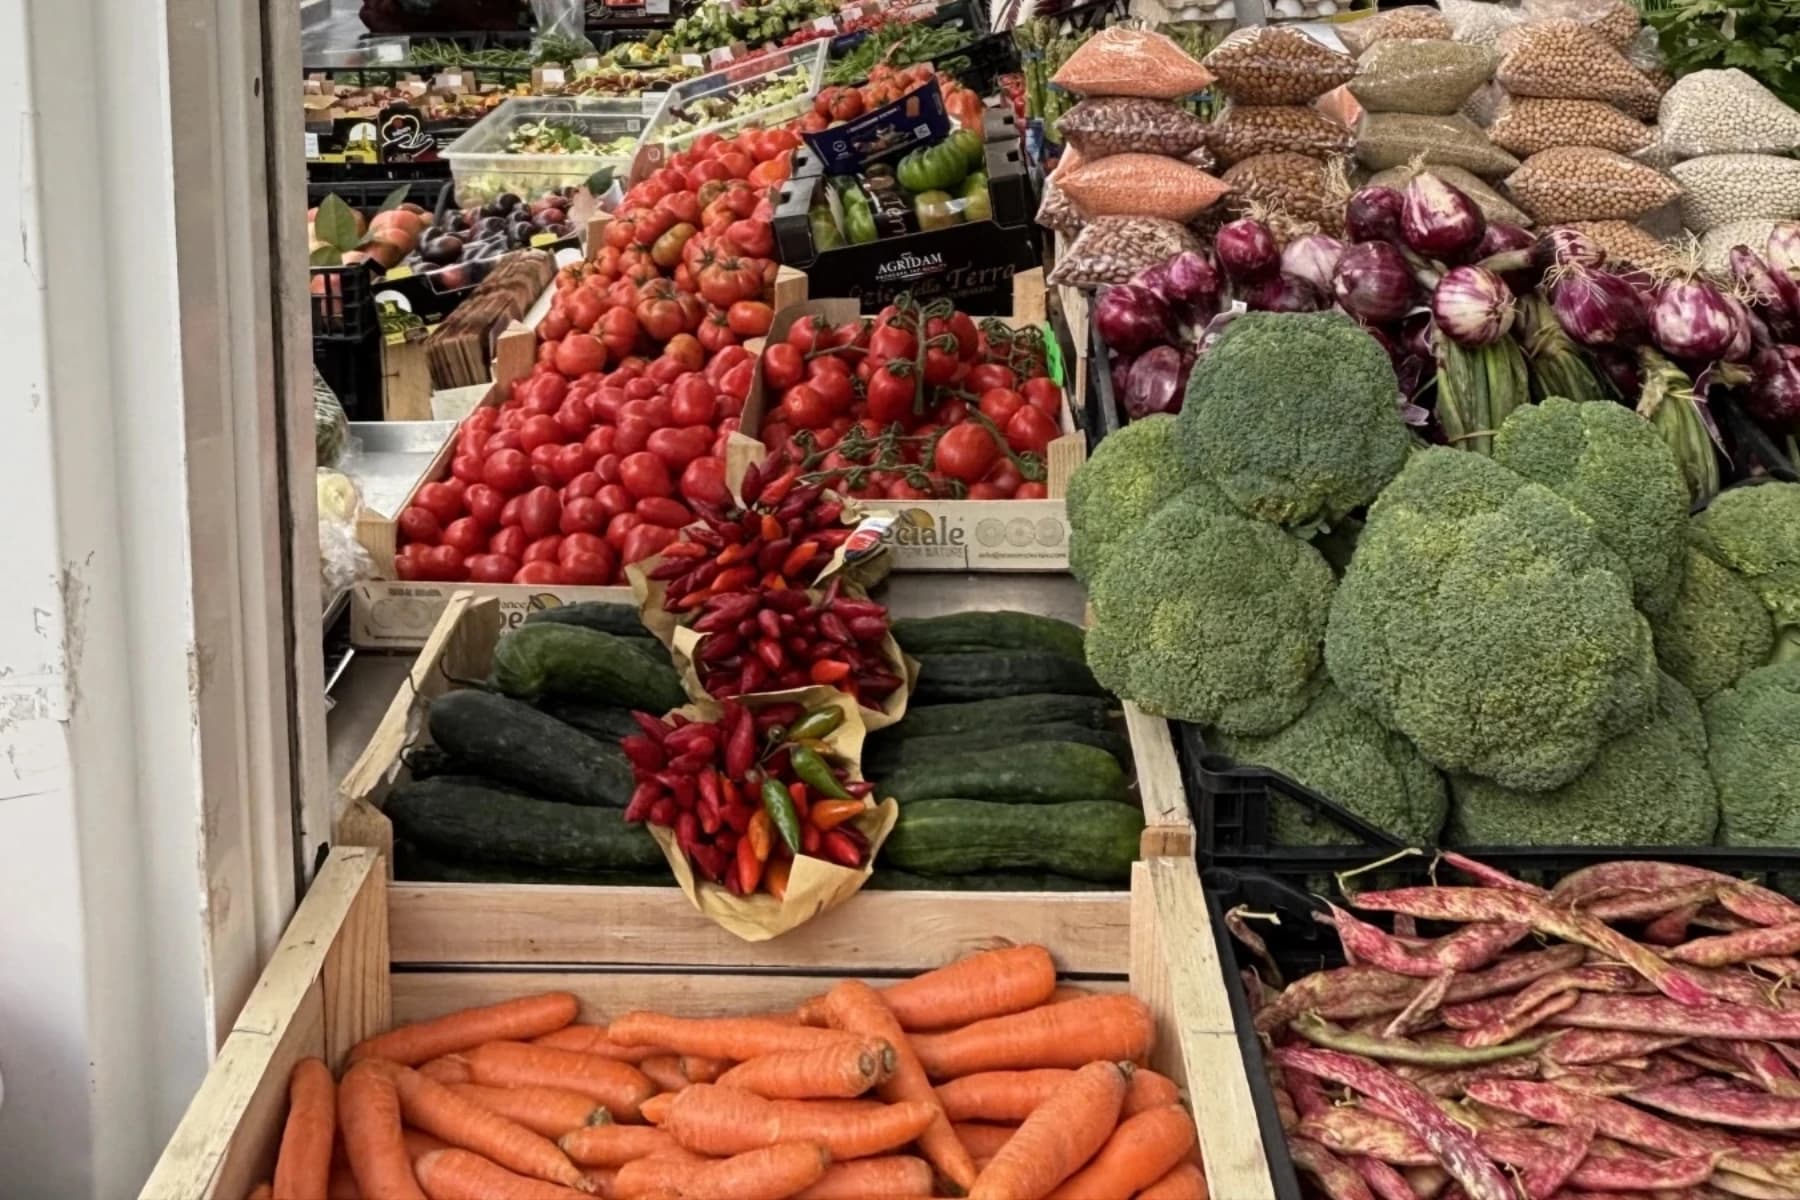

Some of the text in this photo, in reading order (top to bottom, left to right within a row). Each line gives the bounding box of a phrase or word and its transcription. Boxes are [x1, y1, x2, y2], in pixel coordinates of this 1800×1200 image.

[878, 253, 943, 275] AGRIDAM
[946, 260, 1015, 288] Terra
[880, 516, 965, 546] eciale
